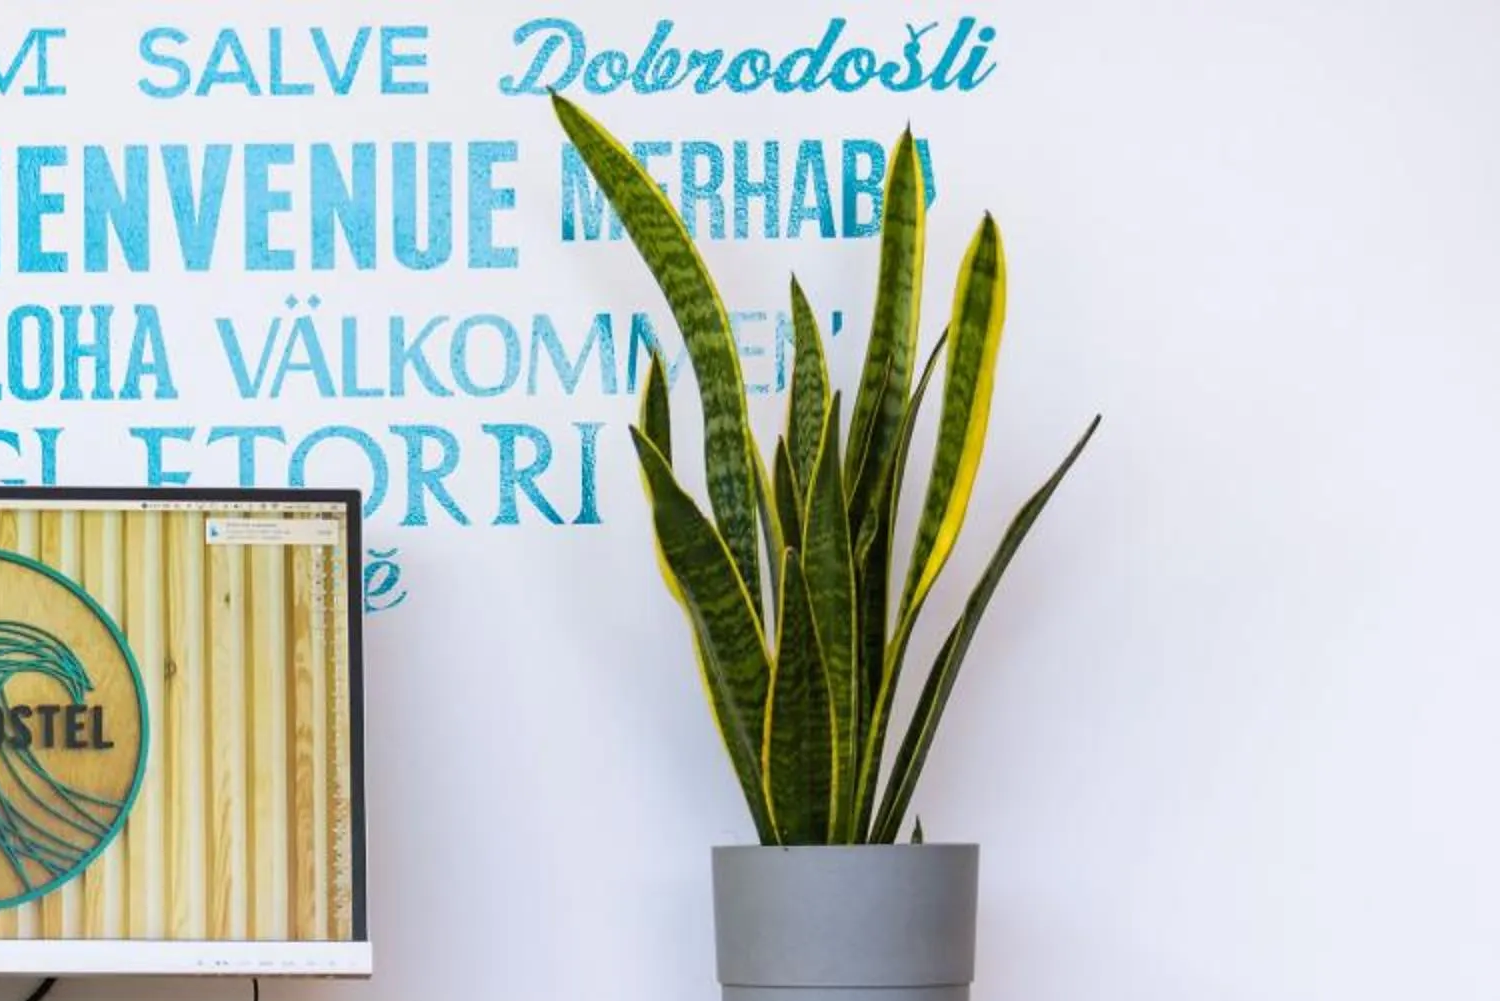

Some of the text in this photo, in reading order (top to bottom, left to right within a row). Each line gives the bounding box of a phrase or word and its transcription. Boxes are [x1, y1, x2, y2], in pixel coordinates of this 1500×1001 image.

[138, 26, 430, 97] SALVE
[498, 15, 998, 97] Dobrodošli
[129, 422, 606, 526] ETORRI
